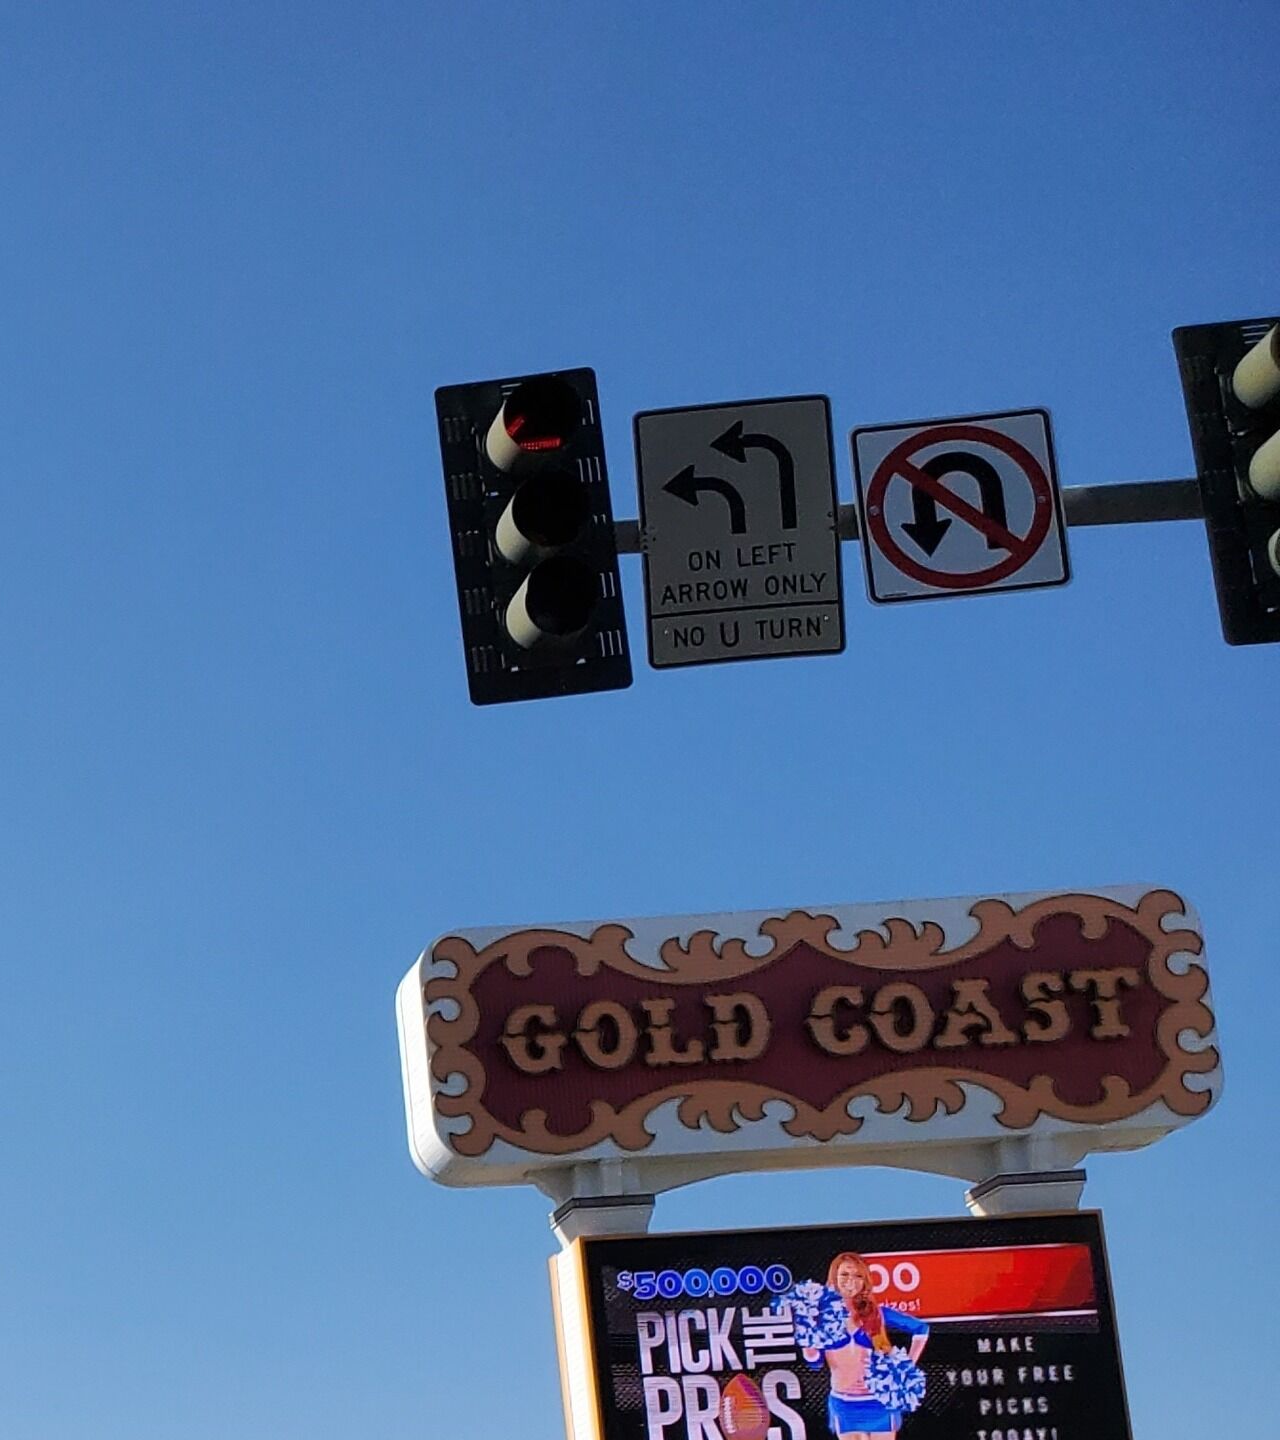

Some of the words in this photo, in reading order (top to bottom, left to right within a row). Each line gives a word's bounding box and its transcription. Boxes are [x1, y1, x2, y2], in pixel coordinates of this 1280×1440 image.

[689, 550, 721, 572] ON
[737, 543, 796, 568] LEFT
[661, 578, 748, 606] ARROW
[765, 572, 827, 596] ONLY
[673, 626, 705, 649] NO
[719, 621, 740, 648] U
[754, 617, 821, 641] TURN
[498, 991, 772, 1074] GOLD
[805, 967, 1140, 1056] COAST
[617, 1264, 792, 1299] $500,000
[636, 1307, 743, 1374] PICK
[740, 1306, 797, 1370] THE
[977, 1336, 1034, 1352] MAKE
[946, 1368, 1005, 1386] YOUR
[1017, 1364, 1074, 1383] FREE
[979, 1396, 1049, 1415] PICKS
